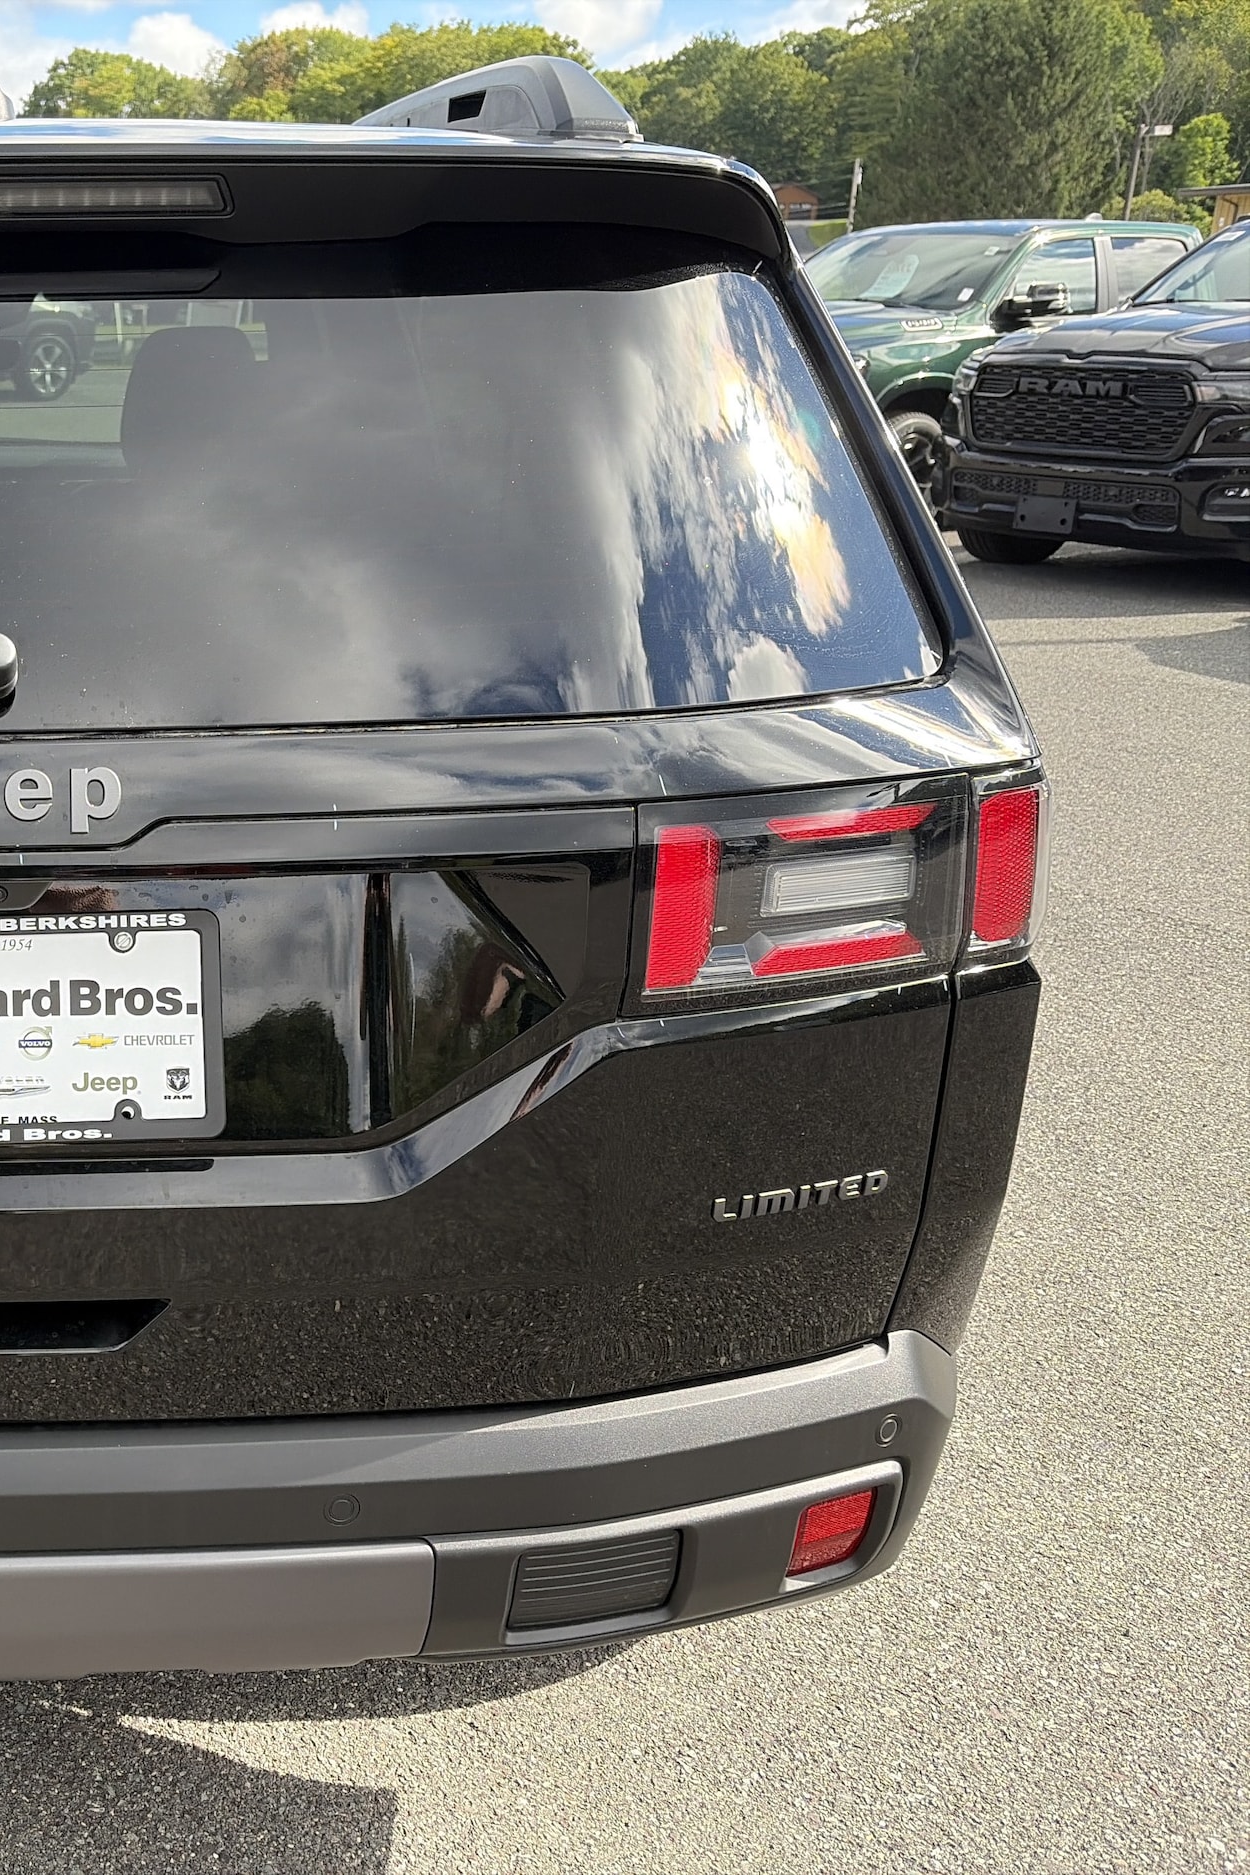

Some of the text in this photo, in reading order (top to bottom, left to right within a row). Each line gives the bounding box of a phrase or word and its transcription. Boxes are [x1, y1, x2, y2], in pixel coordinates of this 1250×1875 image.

[1018, 376, 1124, 397] RAM
[0, 914, 186, 932] BERKSHIRES
[2, 938, 33, 951] 1954
[19, 1040, 51, 1048] VOLVO
[123, 1034, 195, 1047] CHEVROLET
[71, 1072, 139, 1095] Jeep
[23, 1127, 113, 1141] Bros.
[712, 1169, 889, 1222] LIMITED
